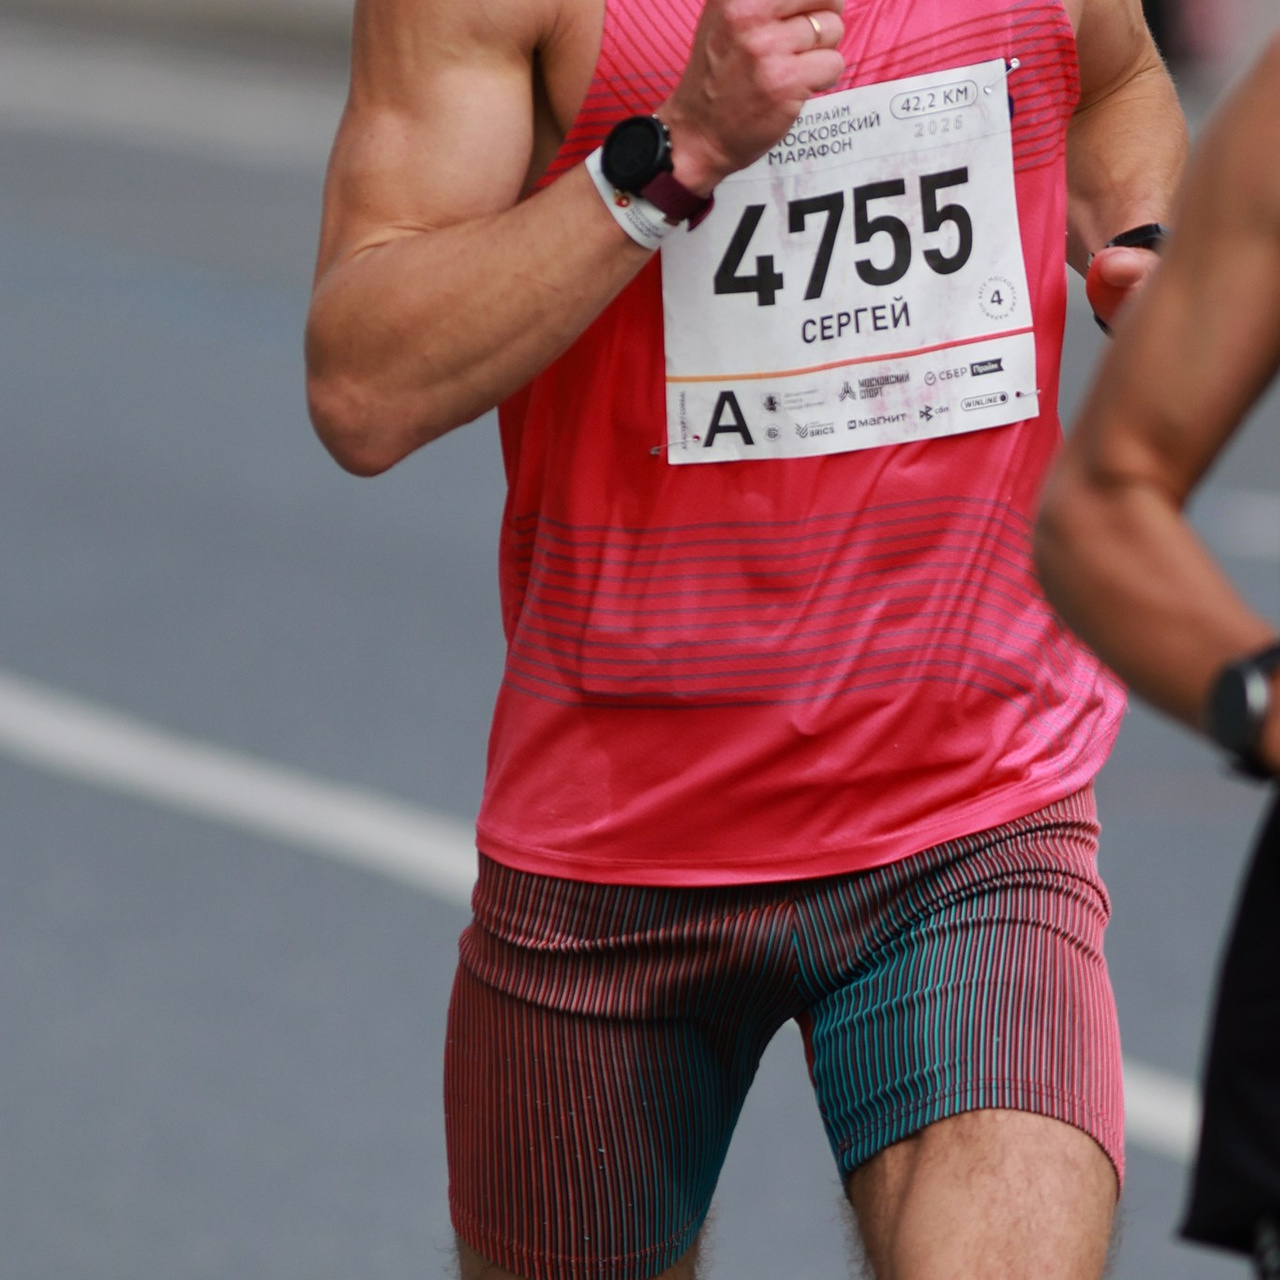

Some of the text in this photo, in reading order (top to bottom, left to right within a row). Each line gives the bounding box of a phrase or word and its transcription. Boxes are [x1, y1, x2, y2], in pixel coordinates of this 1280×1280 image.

[900, 92, 936, 113] 42,2
[768, 138, 853, 166] МАРАФОН
[713, 166, 974, 307] 4755
[990, 289, 1003, 305] 4
[801, 296, 911, 344] СЕРГЕЙ
[964, 395, 998, 409] WINLINE
[703, 390, 755, 448] A
[809, 424, 835, 437] BRICS
